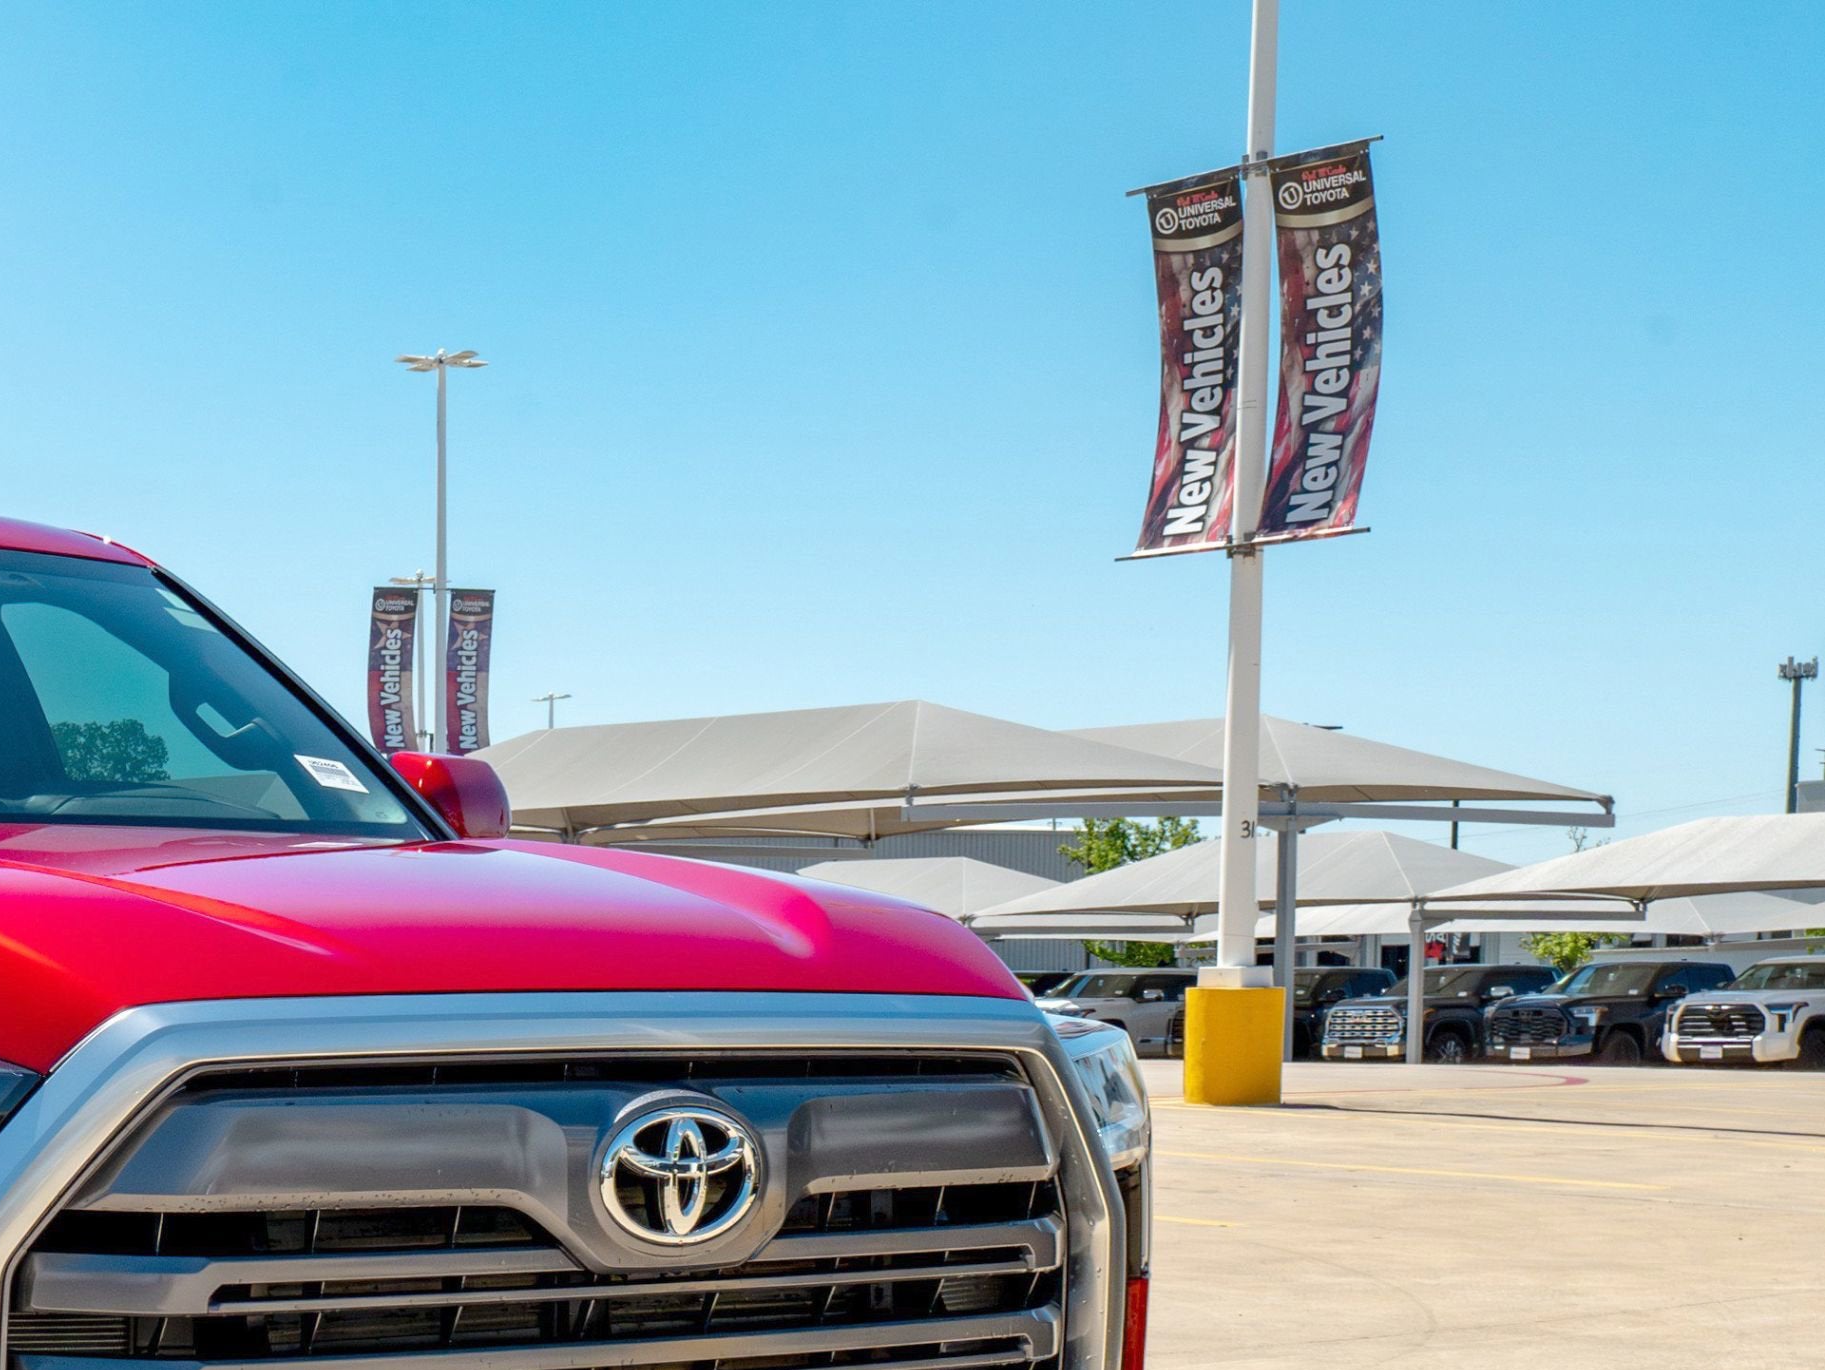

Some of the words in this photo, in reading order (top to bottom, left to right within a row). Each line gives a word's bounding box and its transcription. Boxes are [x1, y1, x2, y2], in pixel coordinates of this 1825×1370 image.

[1303, 170, 1366, 193] UNIVERSAL
[1304, 187, 1350, 206] TOYOTA
[1178, 195, 1237, 218] UNIVERSAL
[1179, 212, 1221, 231] TOYOTA
[1301, 242, 1353, 427] Vehicles
[1180, 266, 1224, 443] Vehicles
[1163, 450, 1217, 536] New
[1285, 434, 1344, 524] New
[380, 628, 402, 705] Vehicles
[457, 629, 479, 706] Vehicles
[384, 710, 405, 748] New
[459, 711, 478, 749] New
[1240, 819, 1255, 839] 31
